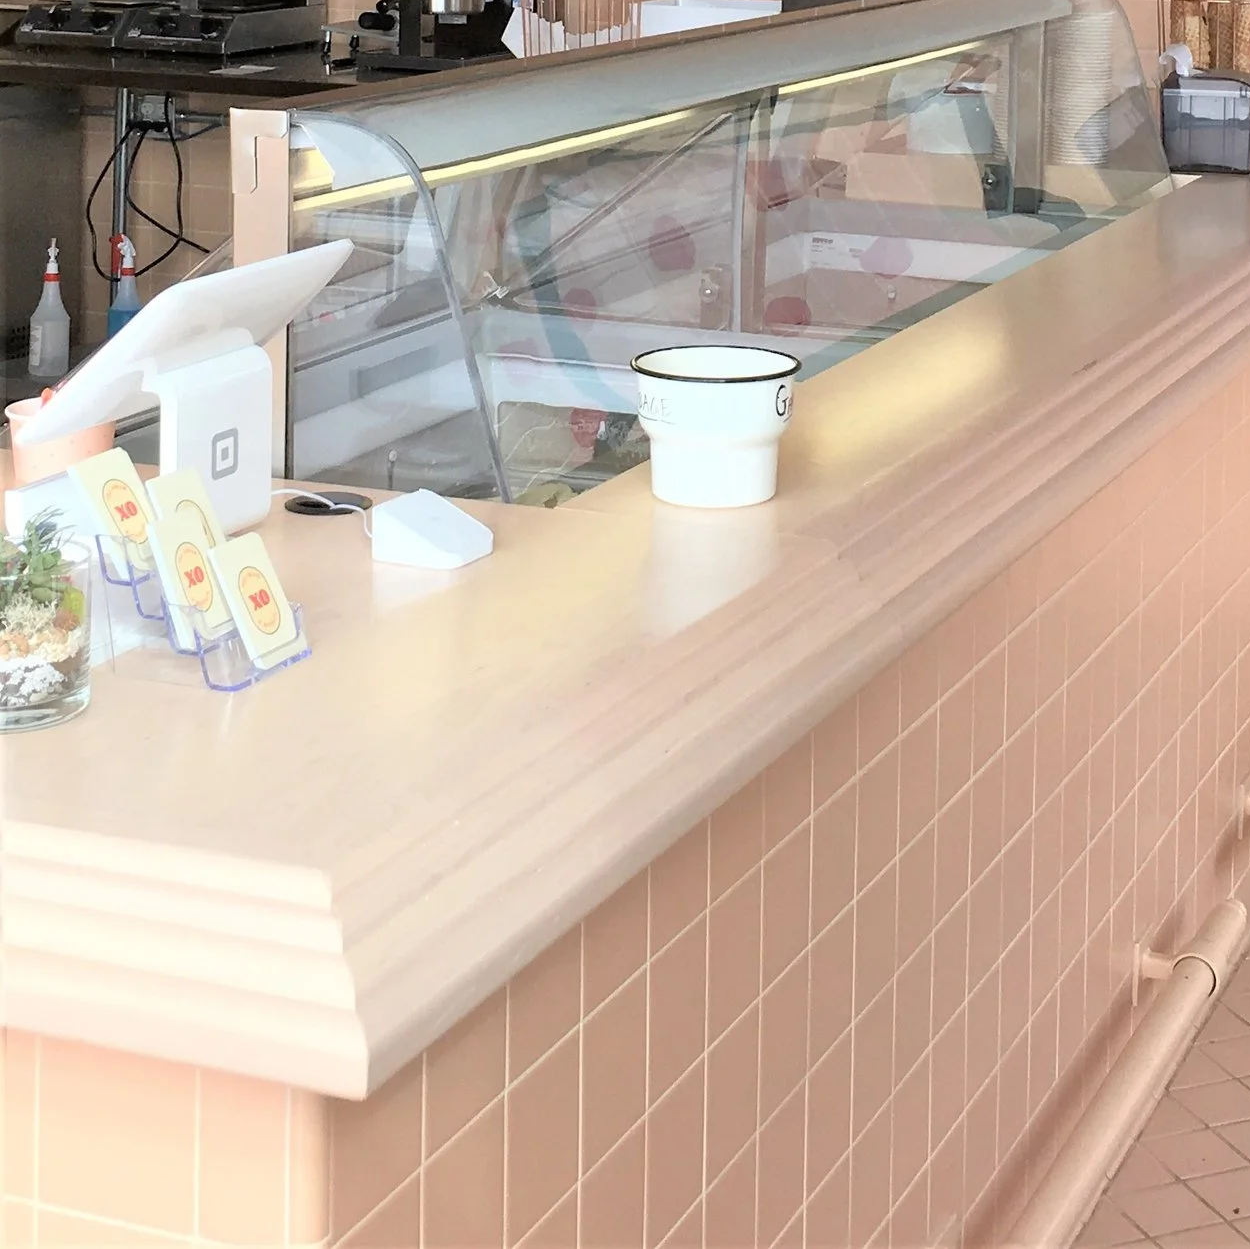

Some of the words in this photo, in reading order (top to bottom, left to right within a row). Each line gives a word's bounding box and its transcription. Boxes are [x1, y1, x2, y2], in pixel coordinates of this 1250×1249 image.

[113, 501, 139, 522] XO
[184, 566, 205, 588] XO
[248, 588, 271, 611] XO
